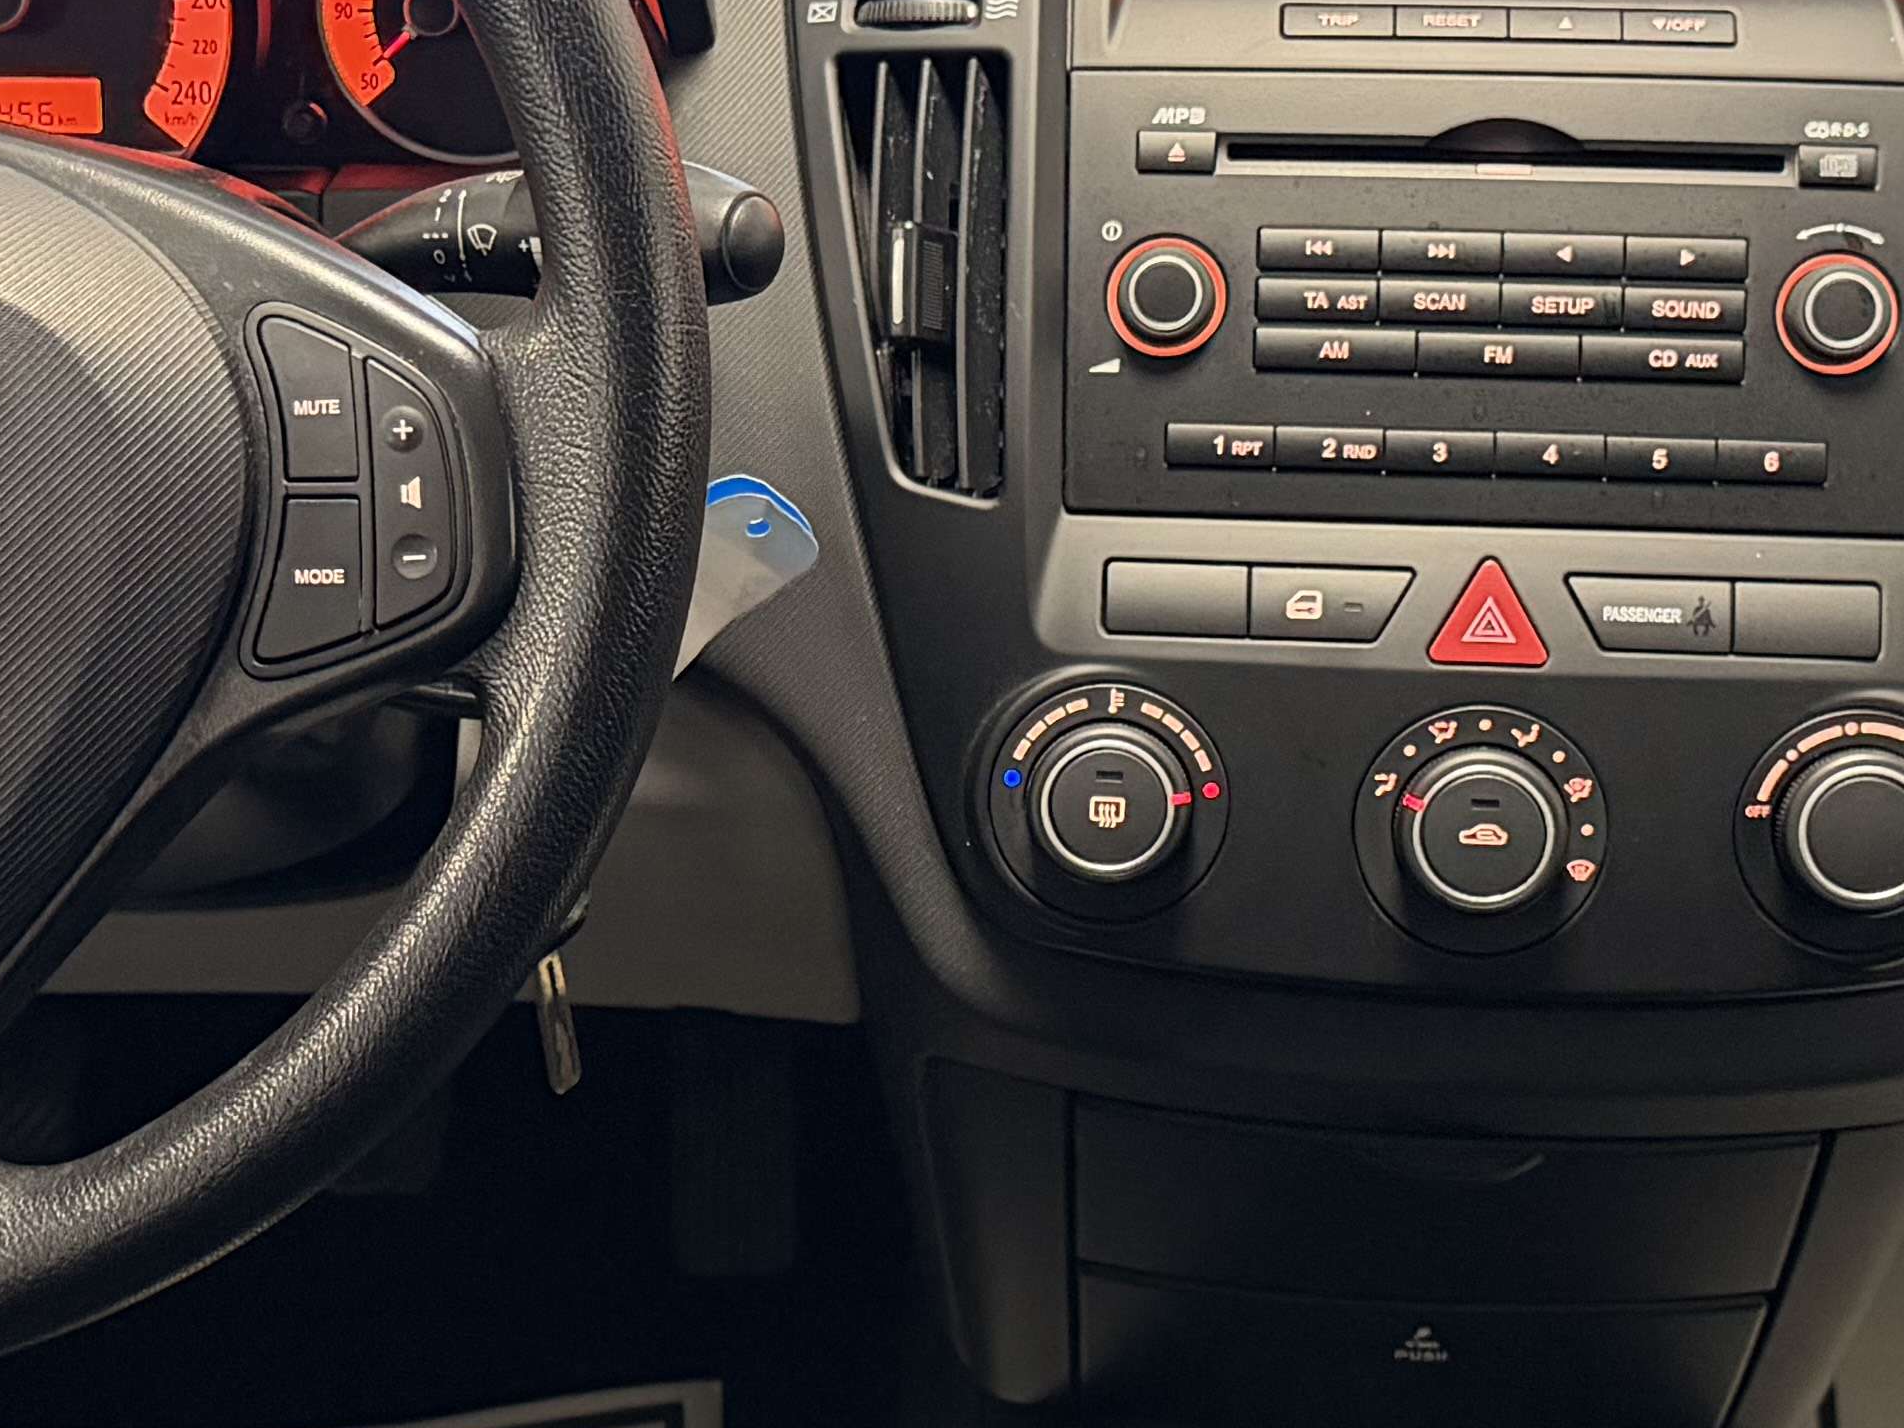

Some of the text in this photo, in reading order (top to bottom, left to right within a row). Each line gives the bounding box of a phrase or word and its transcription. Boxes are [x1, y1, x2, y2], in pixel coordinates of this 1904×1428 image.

[334, 3, 353, 20] 90
[1318, 14, 1360, 27] TRIP
[1423, 14, 1482, 28] RESET
[192, 40, 218, 55] 220
[361, 73, 379, 90] 50
[171, 80, 212, 105] 240
[164, 112, 198, 126] km/h
[1304, 291, 1368, 310] TA AST
[1413, 292, 1466, 311] SCAN
[1531, 296, 1595, 314] SETUP
[1651, 300, 1721, 319] SOUND
[1319, 341, 1350, 359] AM
[1483, 345, 1514, 364] FM
[1648, 349, 1718, 368] CD AUX
[294, 399, 341, 415] MUTE
[1213, 435, 1264, 456] 1 RPT
[1321, 438, 1377, 460] 2 RND
[1432, 442, 1448, 463] 3
[1542, 444, 1560, 465] 4
[1652, 448, 1669, 470] 5
[1764, 451, 1780, 473] 6
[294, 569, 345, 585] MODE
[1602, 605, 1683, 624] PASSENGER
